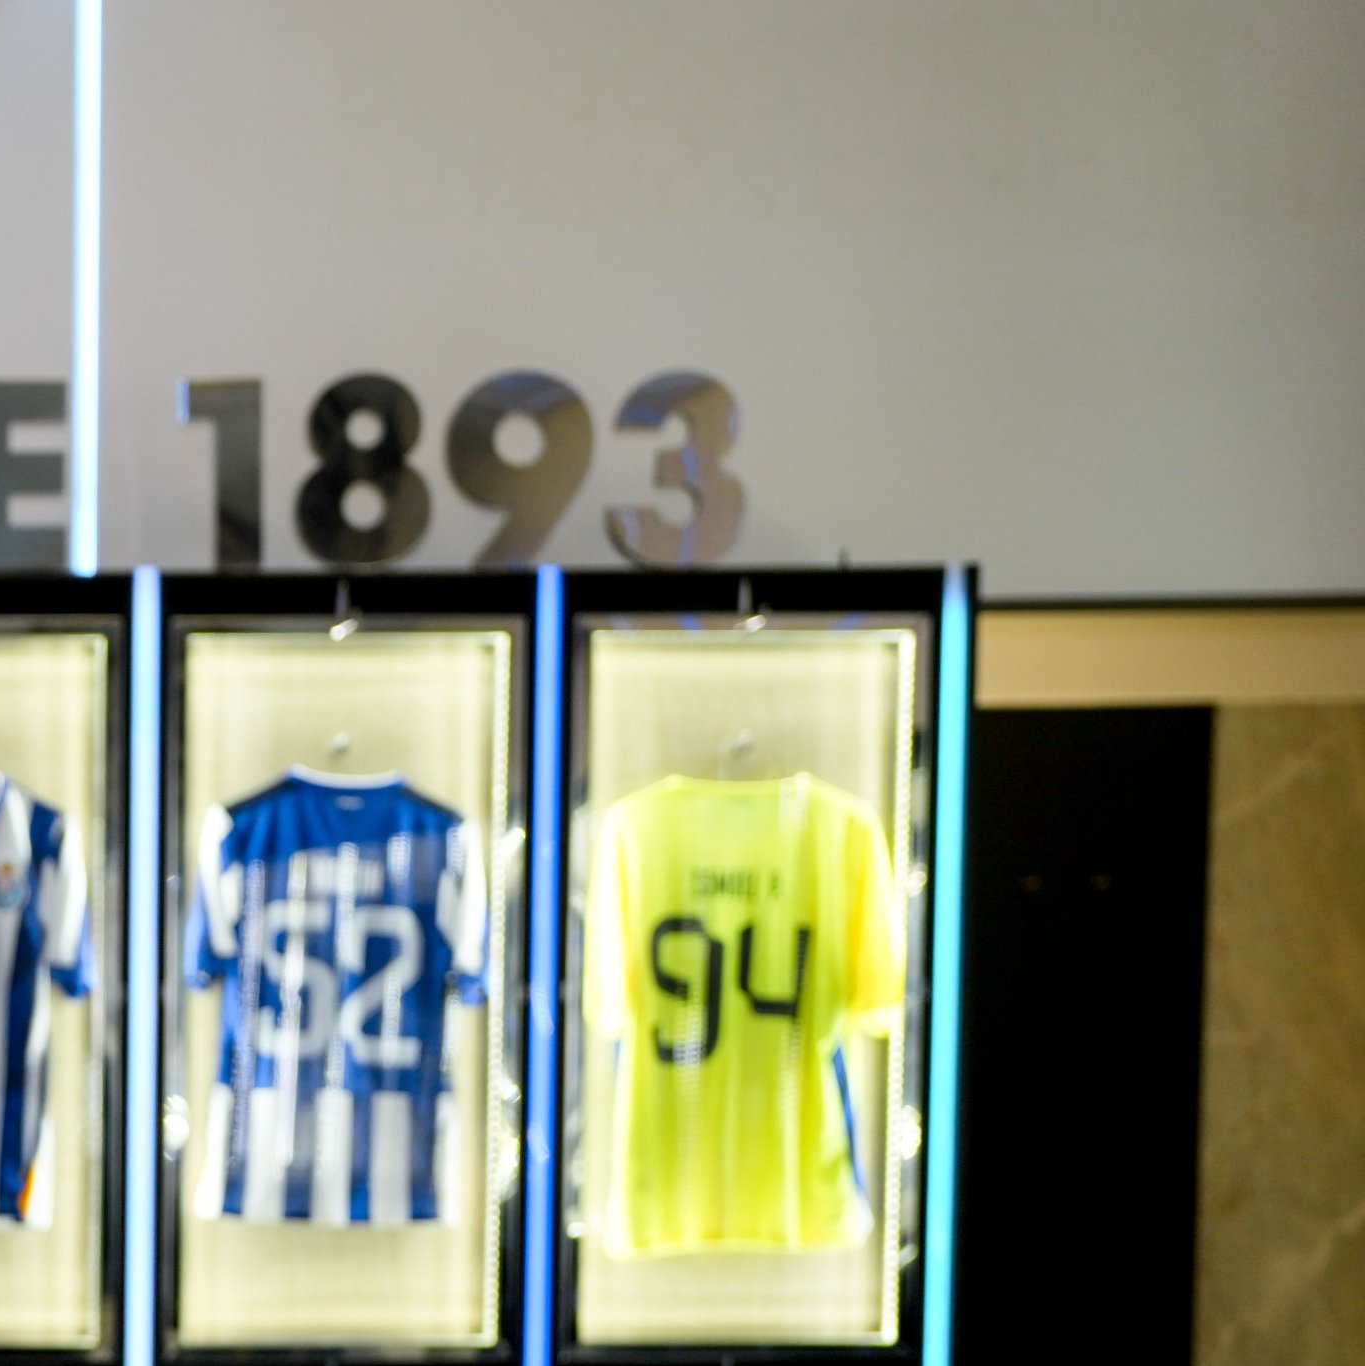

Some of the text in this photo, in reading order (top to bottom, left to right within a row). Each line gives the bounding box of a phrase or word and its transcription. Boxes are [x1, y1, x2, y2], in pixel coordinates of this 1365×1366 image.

[176, 368, 746, 574] 1893
[255, 900, 426, 1068] 52
[650, 916, 811, 1067] 94
